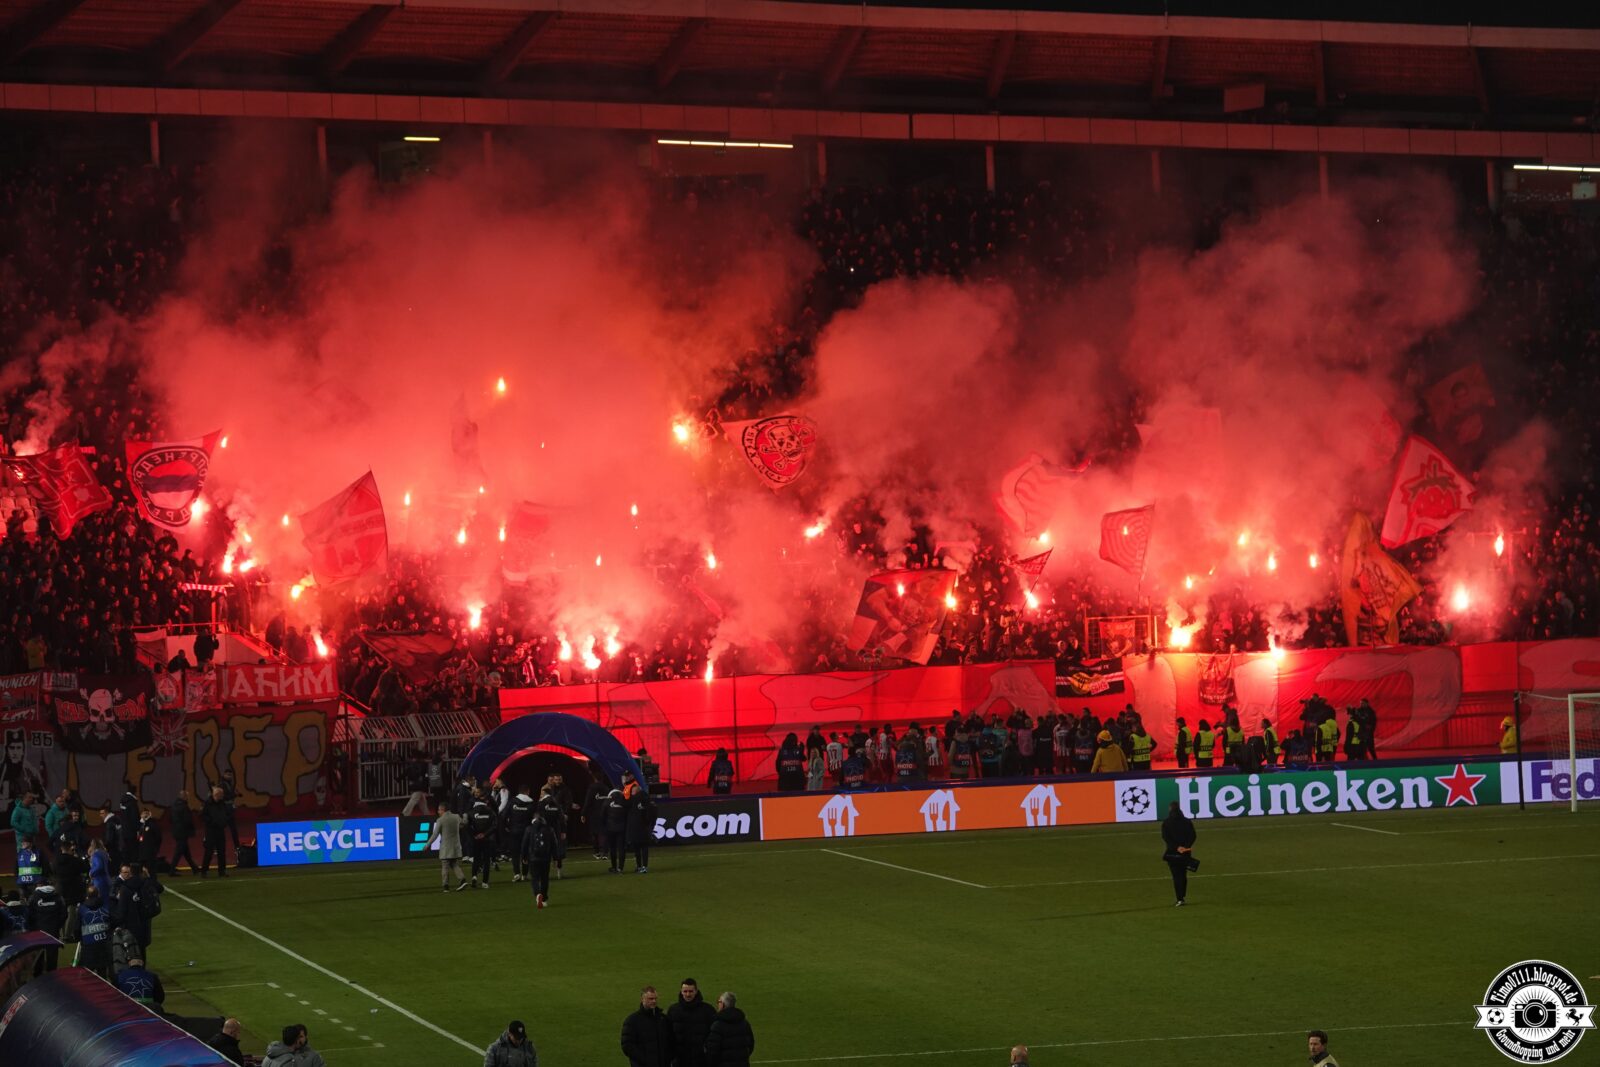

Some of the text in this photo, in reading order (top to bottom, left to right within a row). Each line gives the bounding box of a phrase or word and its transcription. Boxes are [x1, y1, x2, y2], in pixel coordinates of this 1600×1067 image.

[1175, 770, 1432, 819] Heineken
[1531, 759, 1600, 800] Fed
[269, 827, 384, 853] RECYCLE
